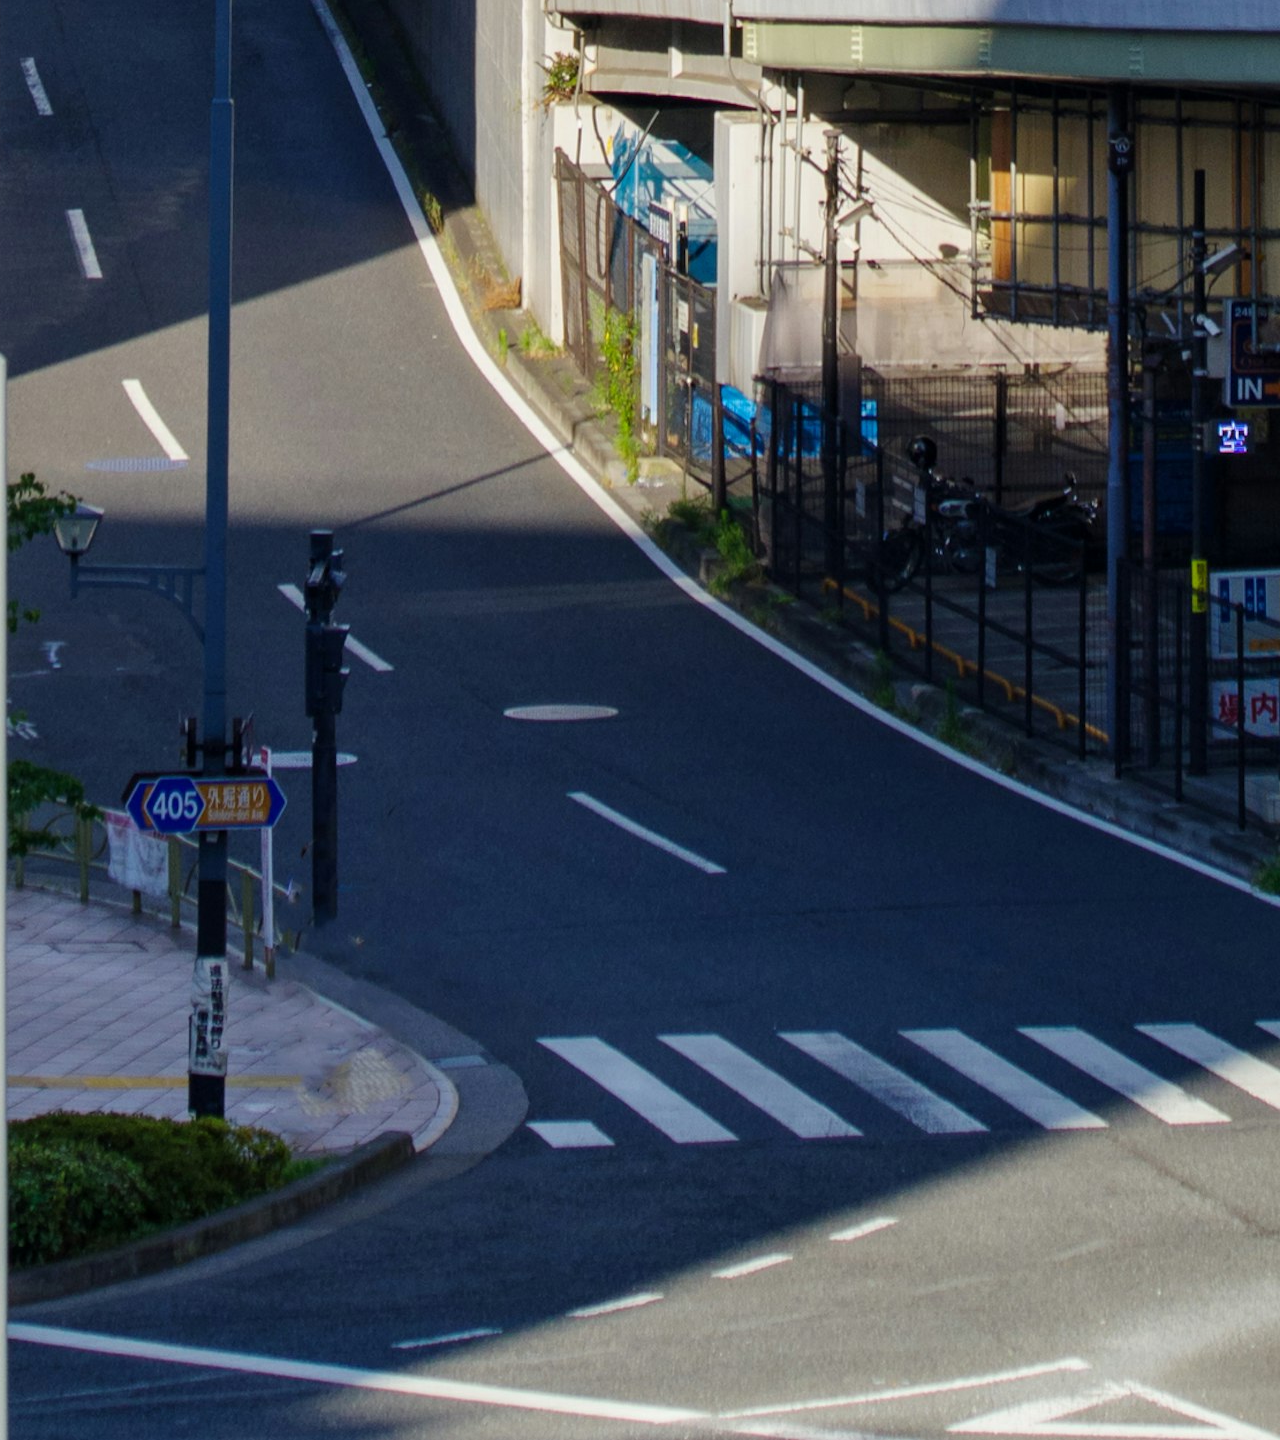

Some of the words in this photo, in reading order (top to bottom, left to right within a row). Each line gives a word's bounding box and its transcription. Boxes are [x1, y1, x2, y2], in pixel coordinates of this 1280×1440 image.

[1237, 377, 1263, 400] IN
[1217, 420, 1249, 454] 空
[152, 791, 198, 821] 405
[207, 785, 265, 809] 外堀通り
